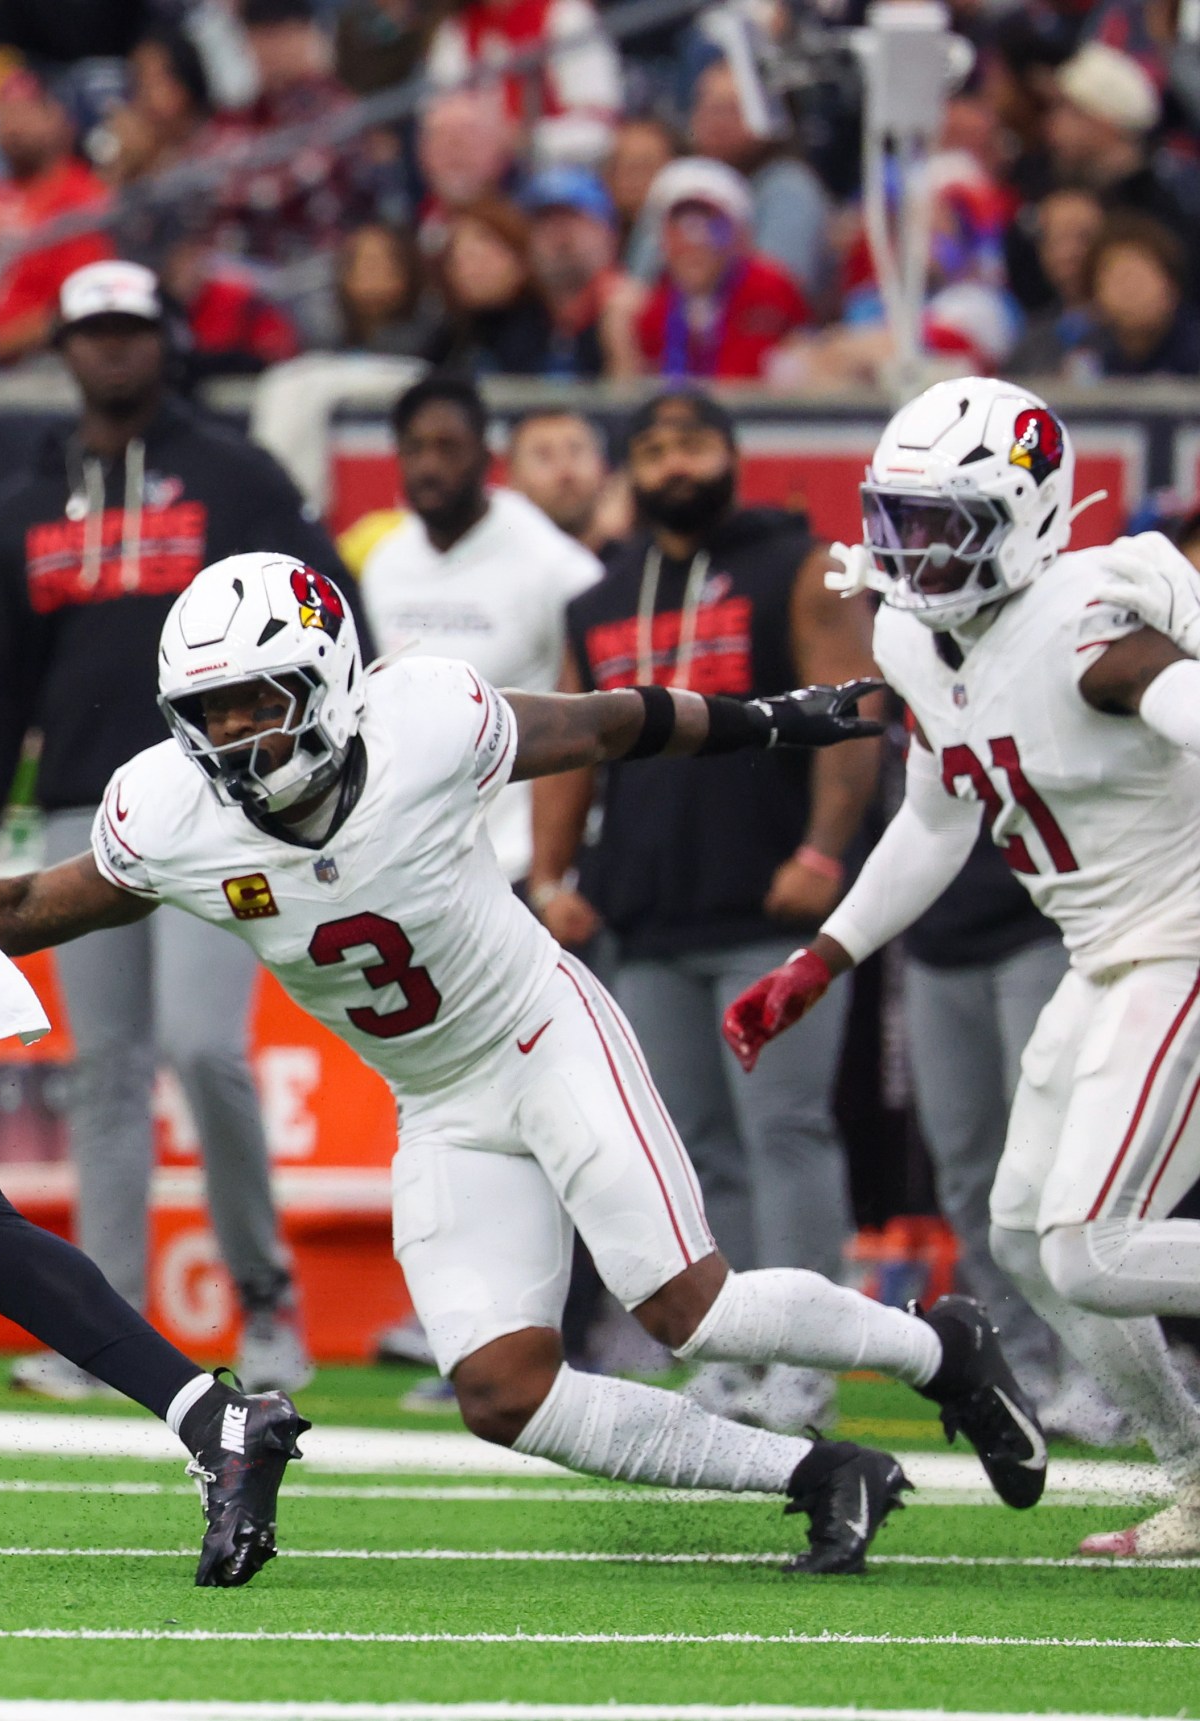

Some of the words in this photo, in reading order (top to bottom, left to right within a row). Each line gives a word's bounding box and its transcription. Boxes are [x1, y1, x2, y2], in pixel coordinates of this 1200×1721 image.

[186, 662, 228, 677] CARDINALS
[942, 736, 1080, 875] 21
[227, 877, 270, 909] C
[308, 911, 442, 1039] 3
[220, 1403, 248, 1456] NIKE
